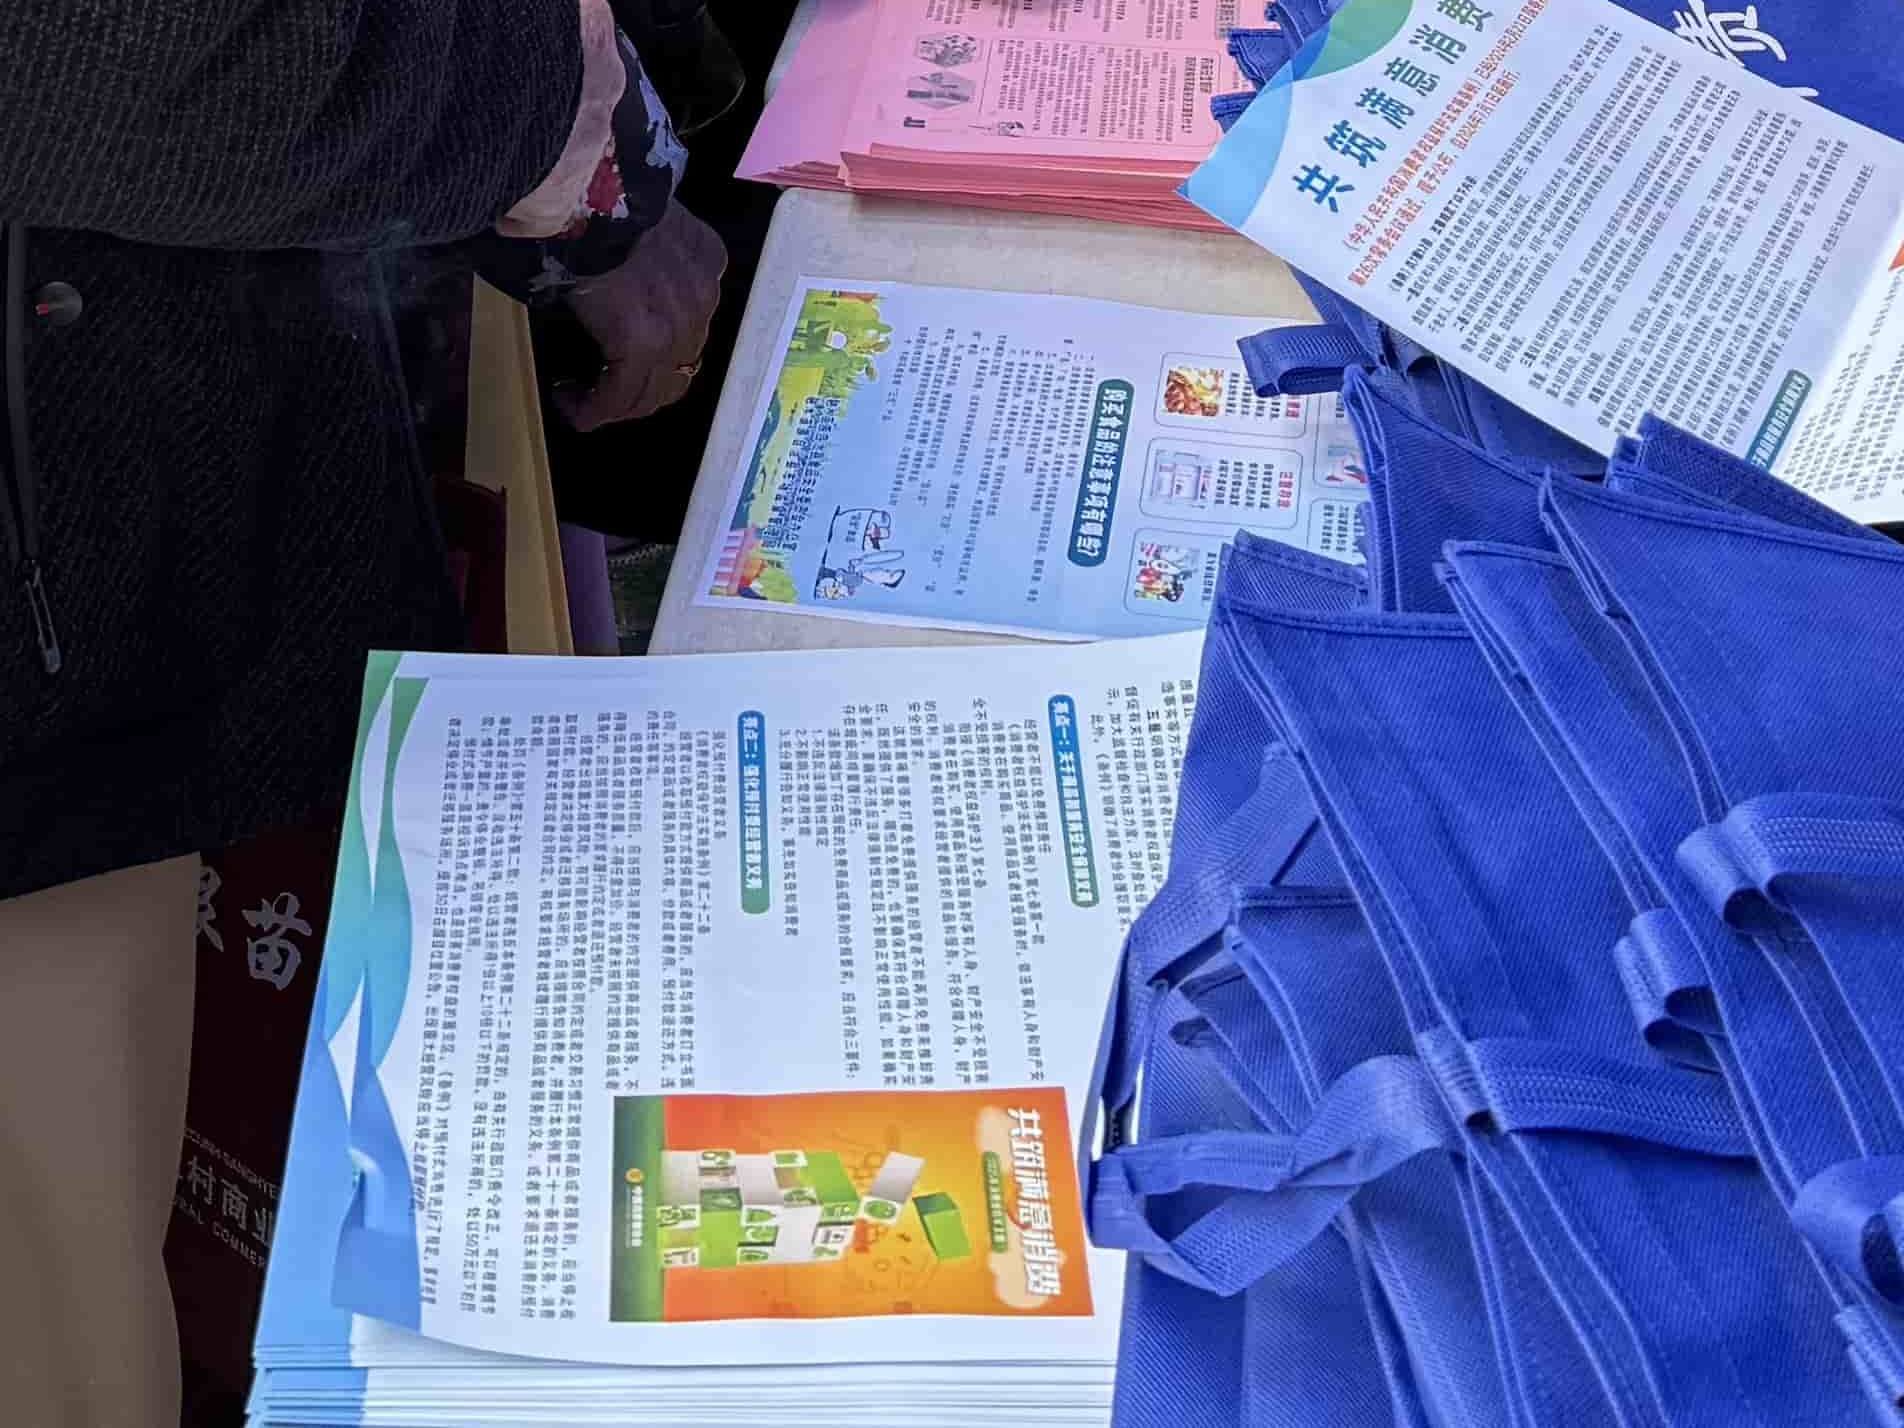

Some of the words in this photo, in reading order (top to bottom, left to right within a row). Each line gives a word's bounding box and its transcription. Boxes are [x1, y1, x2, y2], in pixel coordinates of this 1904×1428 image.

[1008, 1107, 1061, 1297] 共筑满意消费
